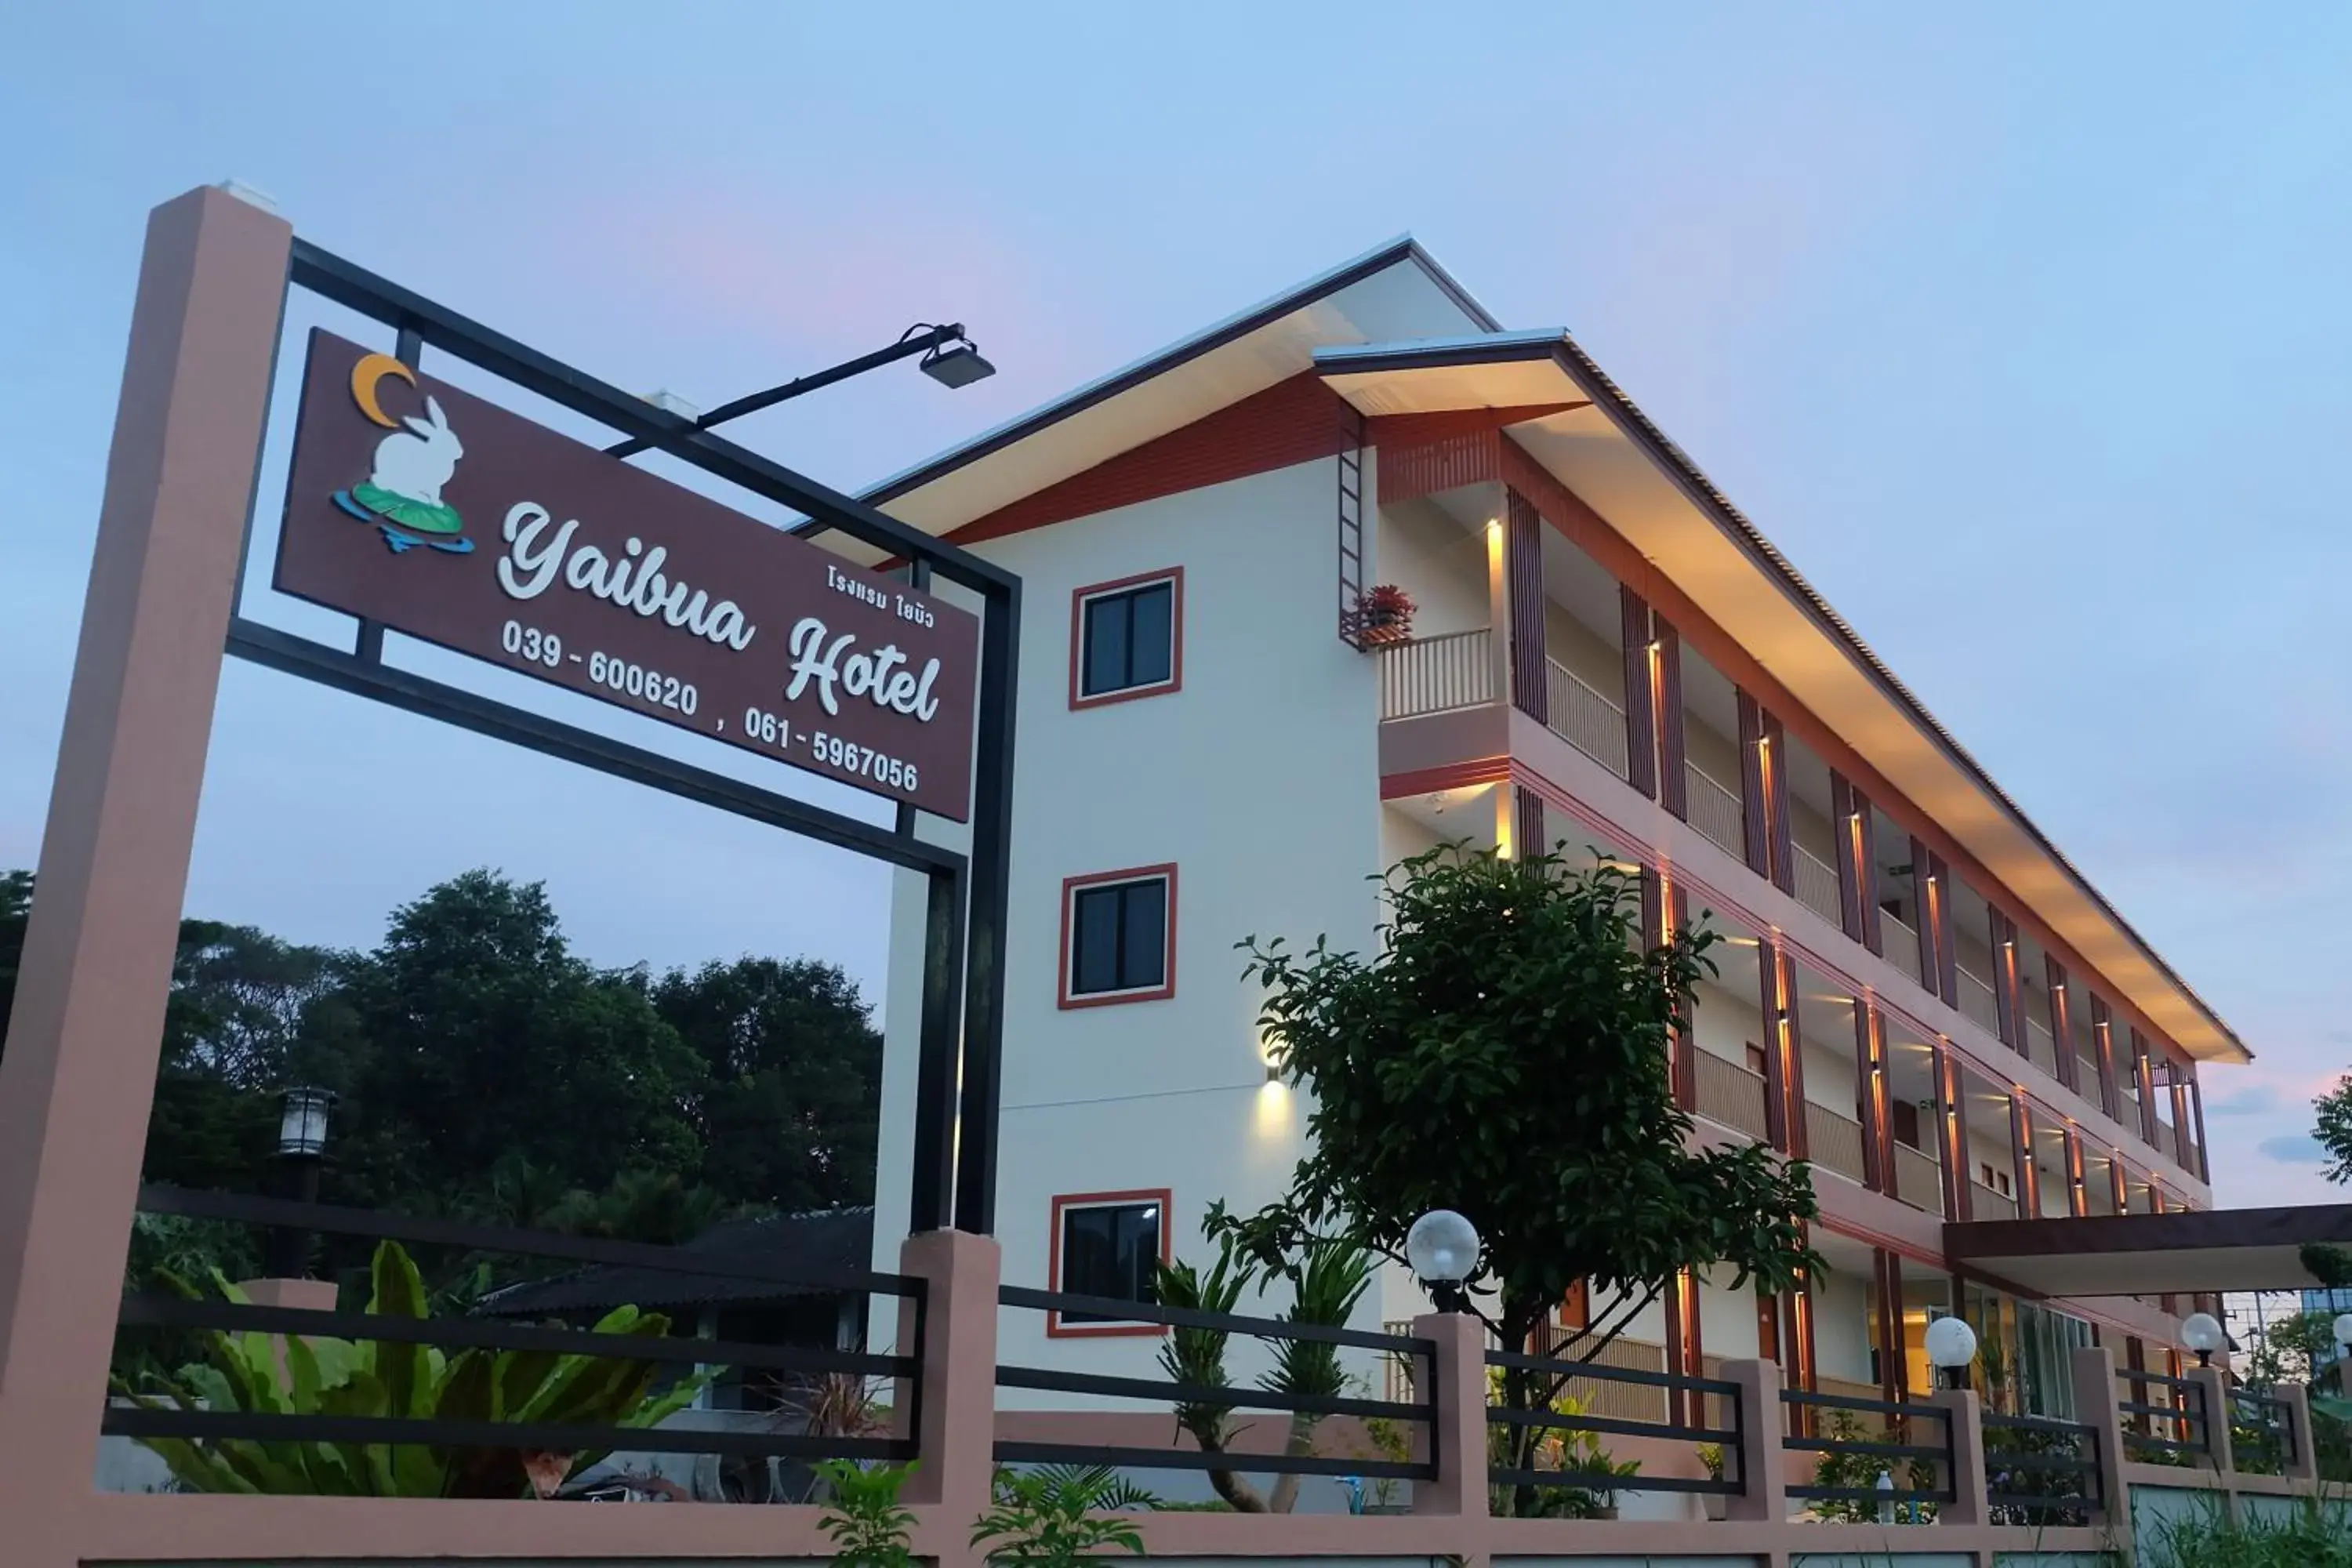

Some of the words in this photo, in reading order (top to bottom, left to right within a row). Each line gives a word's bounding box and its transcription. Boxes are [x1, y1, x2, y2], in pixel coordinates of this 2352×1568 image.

[497, 501, 757, 651] Yaibua
[786, 617, 940, 721] Hotel
[827, 564, 887, 609] โรงแรม
[895, 594, 935, 628] ใยบัว
